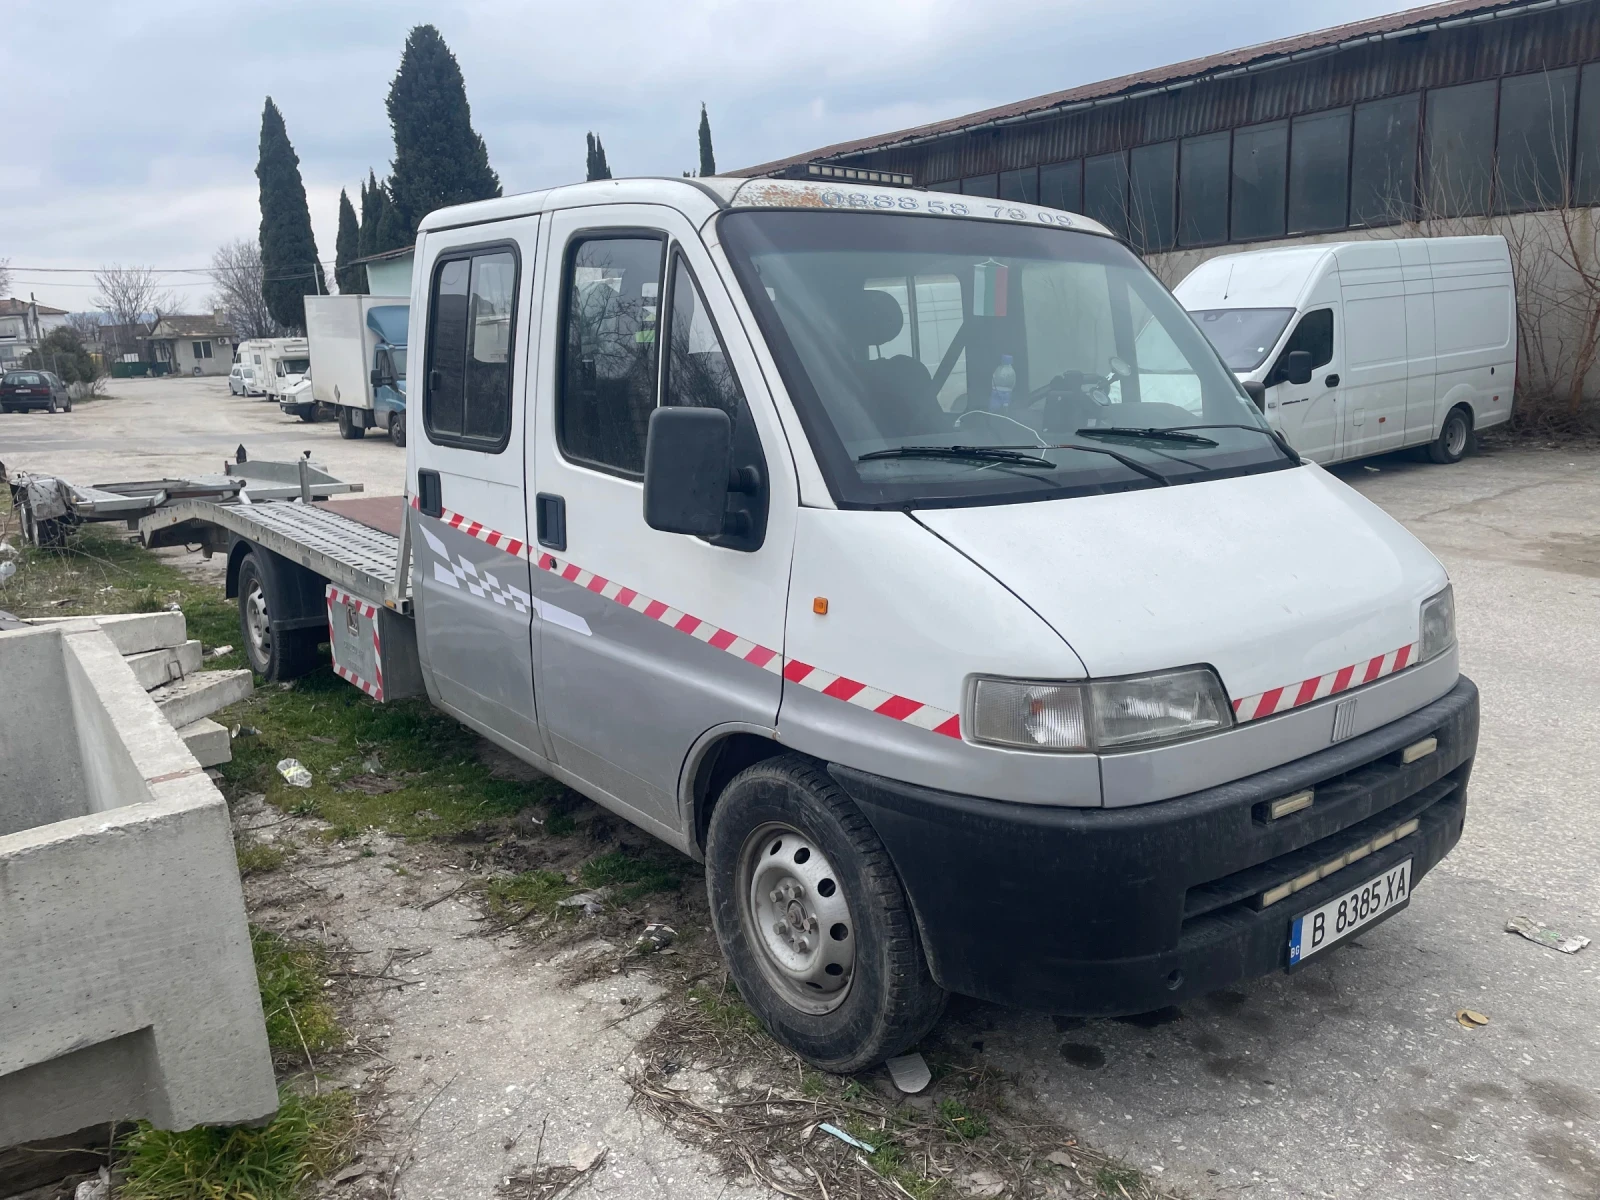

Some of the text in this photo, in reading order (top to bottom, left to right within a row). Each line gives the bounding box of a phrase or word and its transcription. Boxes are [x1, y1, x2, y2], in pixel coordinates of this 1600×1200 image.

[821, 191, 1074, 227] 0888 58 78 09
[1311, 912, 1325, 948] B
[1290, 945, 1300, 958] BG
